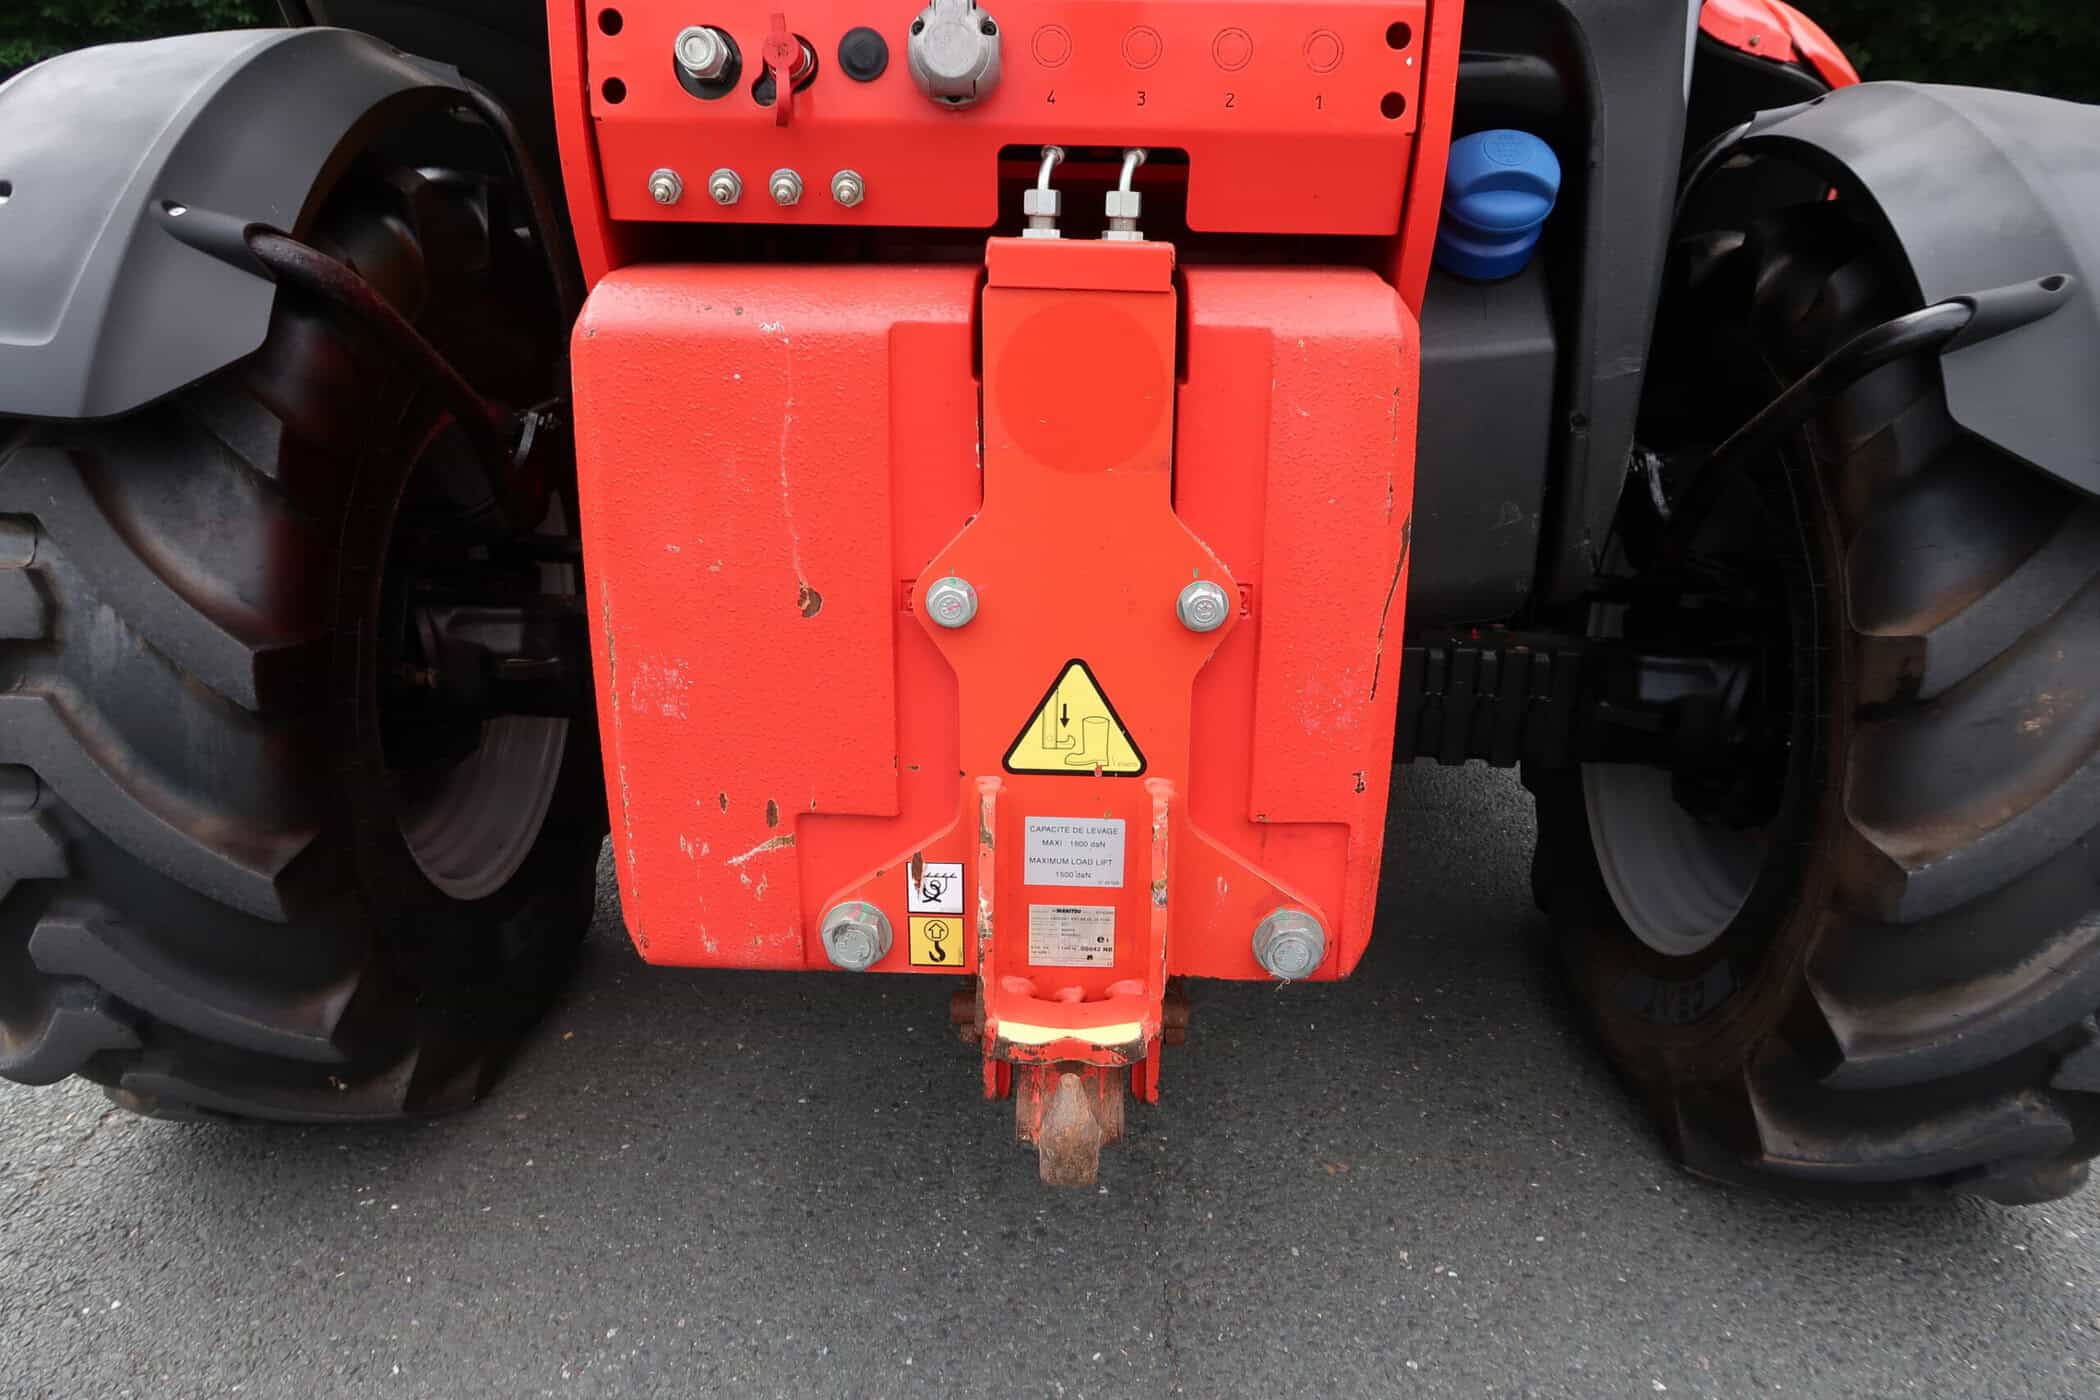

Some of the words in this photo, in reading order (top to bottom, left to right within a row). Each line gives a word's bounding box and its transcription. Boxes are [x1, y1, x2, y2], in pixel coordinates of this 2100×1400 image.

[1046, 89, 1056, 105] 4
[1136, 90, 1146, 106] 3
[1224, 92, 1235, 108] 2
[1314, 94, 1323, 110] 1
[1029, 825, 1070, 833] CAPACITE
[1072, 826, 1084, 835] DE
[1086, 826, 1119, 836] LEVAGE
[1041, 839, 1062, 847] MAXI
[1029, 857, 1069, 865] MAXIMUM
[1071, 858, 1093, 866] LOAD
